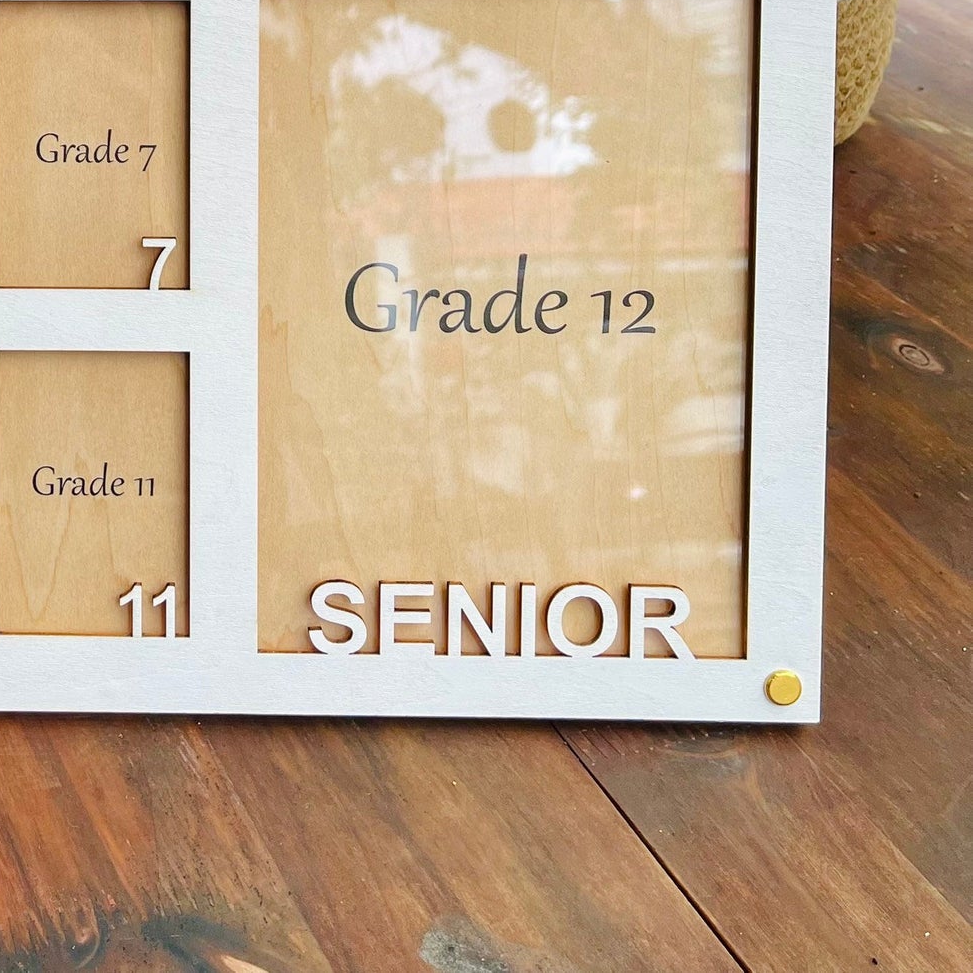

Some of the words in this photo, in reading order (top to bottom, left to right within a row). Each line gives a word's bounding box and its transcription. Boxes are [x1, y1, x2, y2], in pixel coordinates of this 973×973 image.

[35, 129, 129, 164] Grade
[139, 143, 158, 172] 7
[142, 237, 177, 290] 7
[344, 253, 569, 335] Grade
[590, 290, 656, 334] 12
[32, 463, 125, 497] Grade
[133, 477, 155, 497] 11
[119, 582, 176, 637] 11
[308, 579, 696, 660] SENIOR
